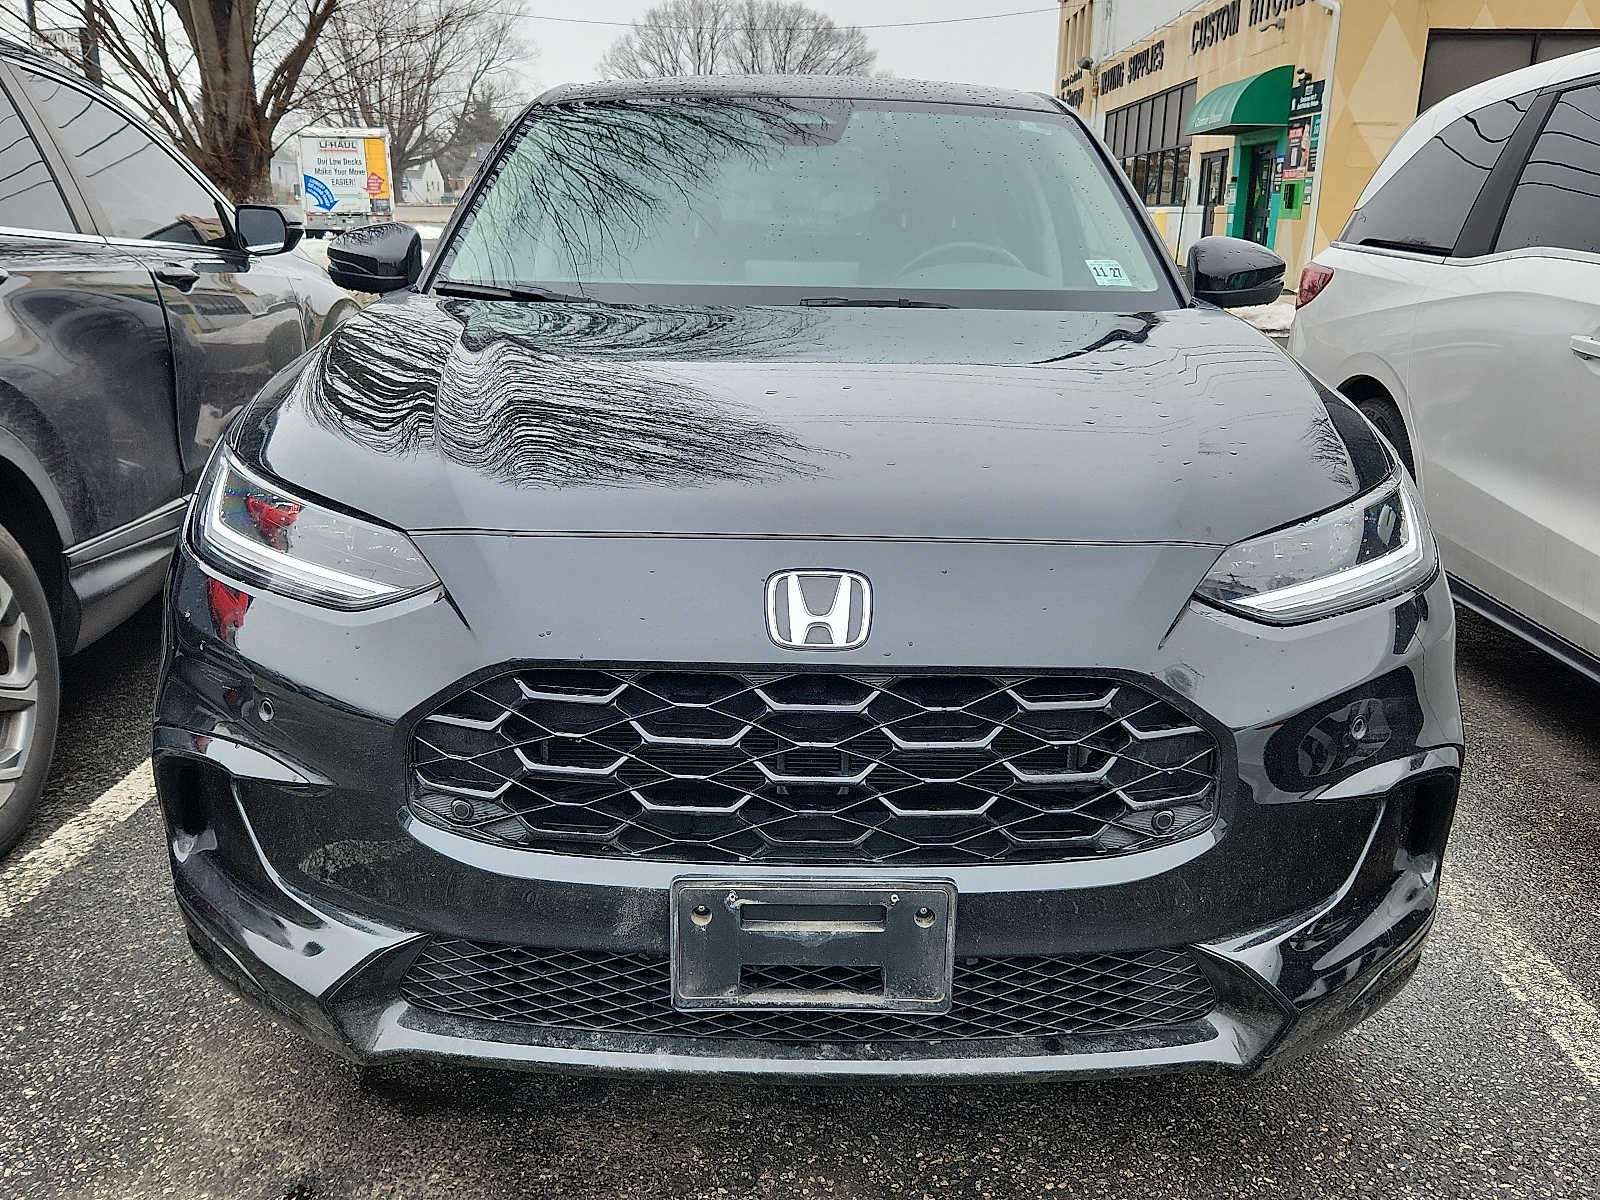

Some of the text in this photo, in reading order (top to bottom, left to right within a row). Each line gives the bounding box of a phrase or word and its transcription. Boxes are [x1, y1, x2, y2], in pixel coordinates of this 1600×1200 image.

[1192, 0, 1241, 56] CUSTOM
[1127, 40, 1165, 84] SUPPLIES
[319, 140, 357, 149] U-HAUL
[317, 157, 363, 166] Our Low Decks
[314, 168, 366, 176] Make Your Move
